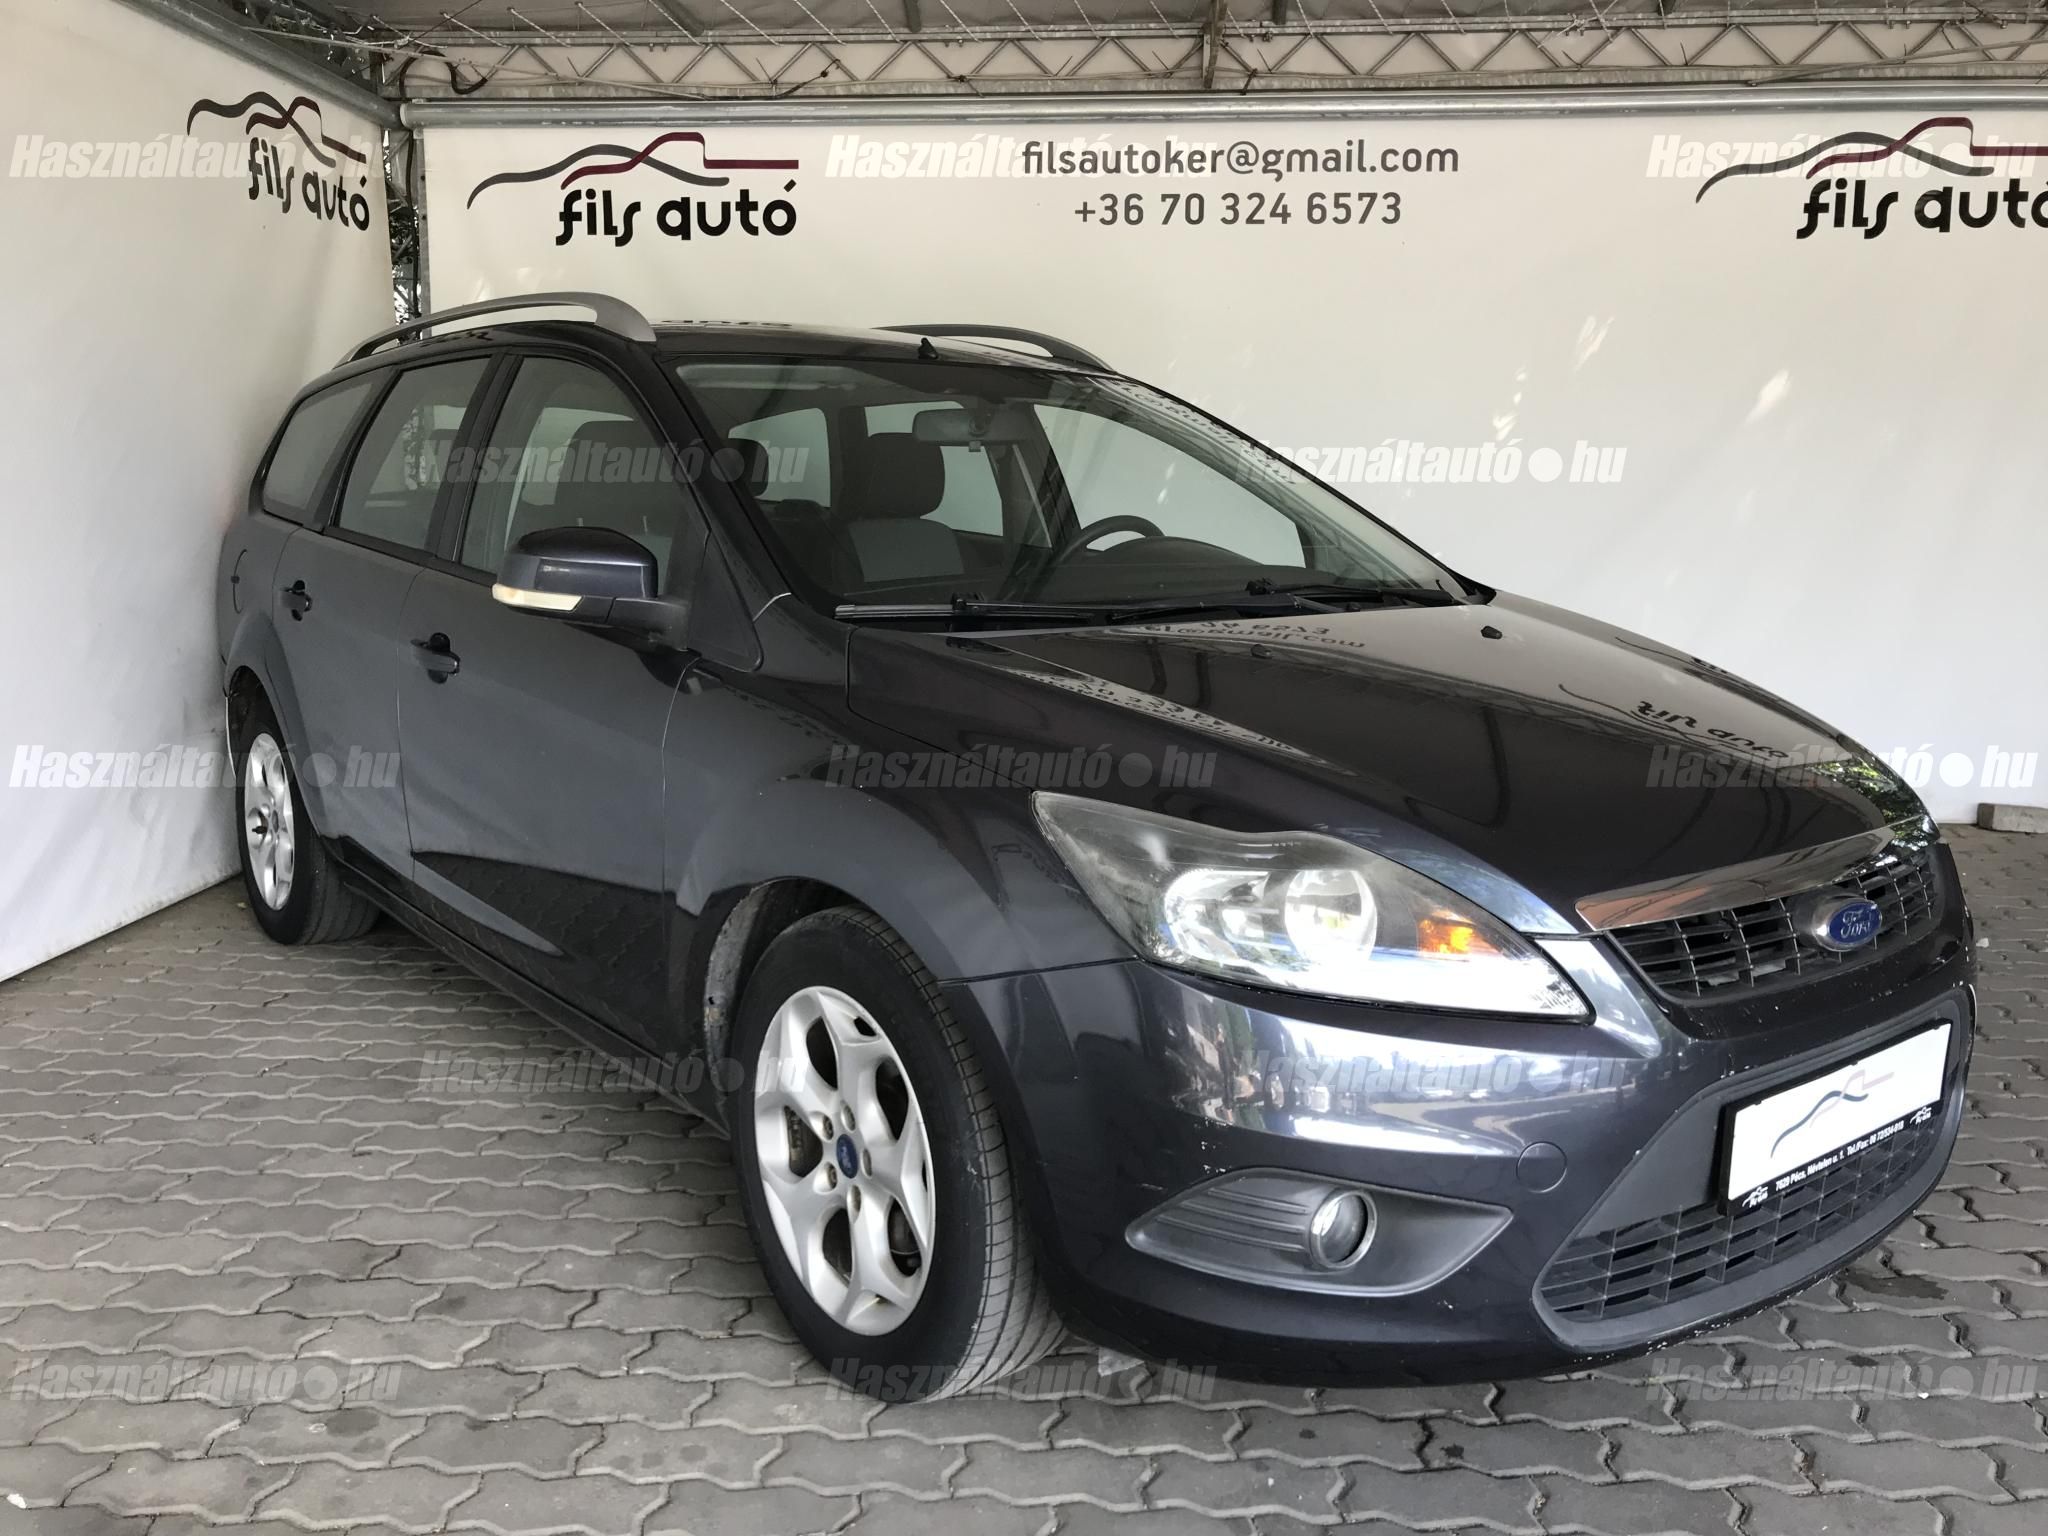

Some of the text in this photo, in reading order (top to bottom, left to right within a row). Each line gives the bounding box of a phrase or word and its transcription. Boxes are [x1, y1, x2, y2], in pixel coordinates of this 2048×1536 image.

[247, 136, 370, 232] fils autó
[1022, 139, 1459, 182] filsautoker@gmail.com
[555, 178, 798, 248] fils autó
[1074, 191, 1403, 226] +36 70 324 6573
[1795, 176, 1899, 240] fils
